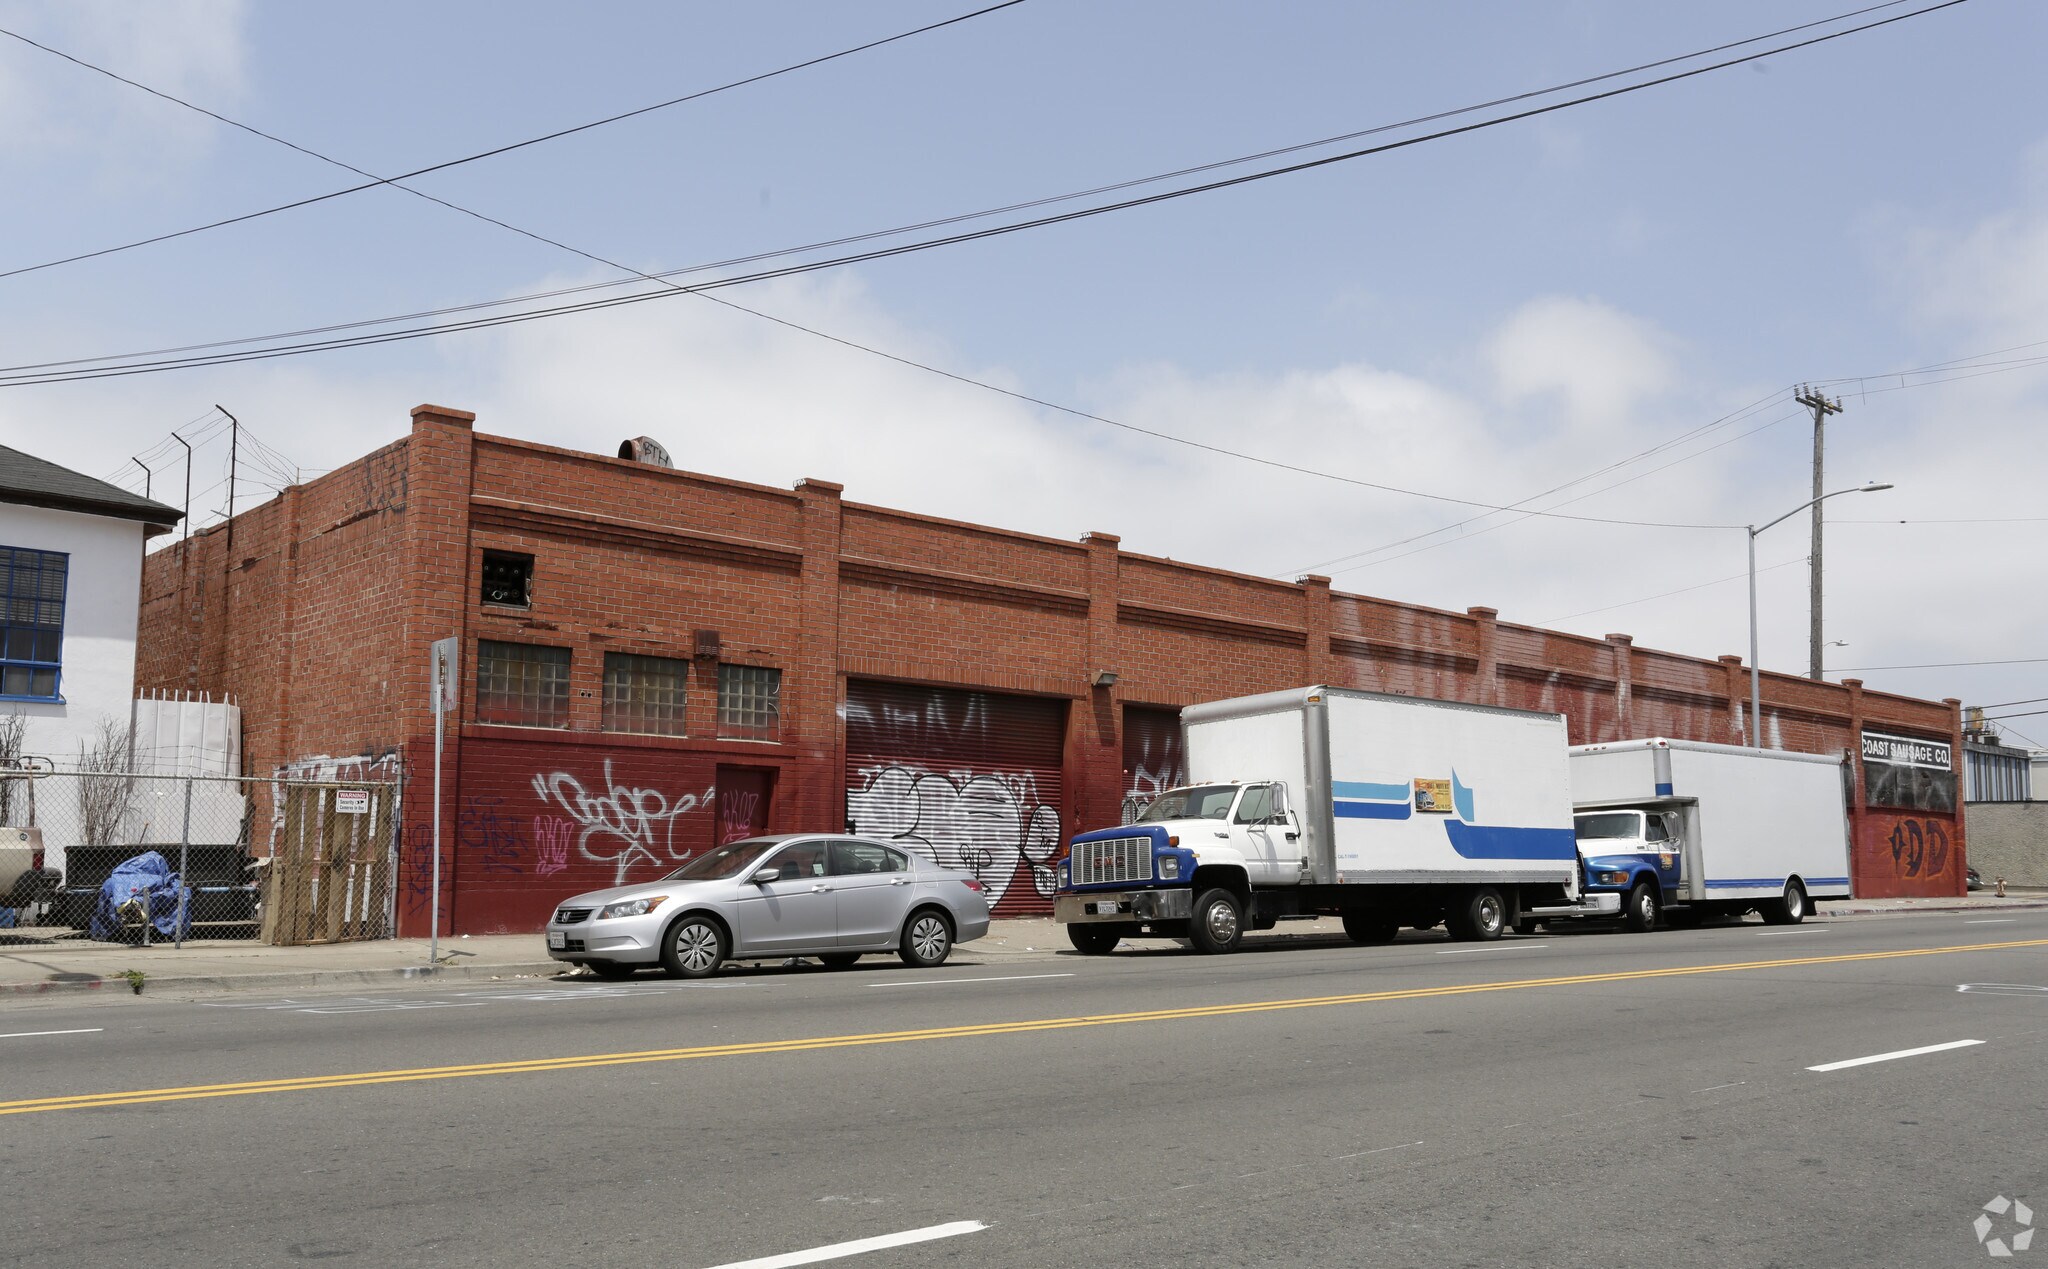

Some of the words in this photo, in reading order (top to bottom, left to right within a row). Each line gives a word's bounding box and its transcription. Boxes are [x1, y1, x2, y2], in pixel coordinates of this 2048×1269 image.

[1862, 739, 1889, 756] COAST
[1890, 742, 1932, 762] SAUSAGE
[1935, 749, 1949, 764] CO.
